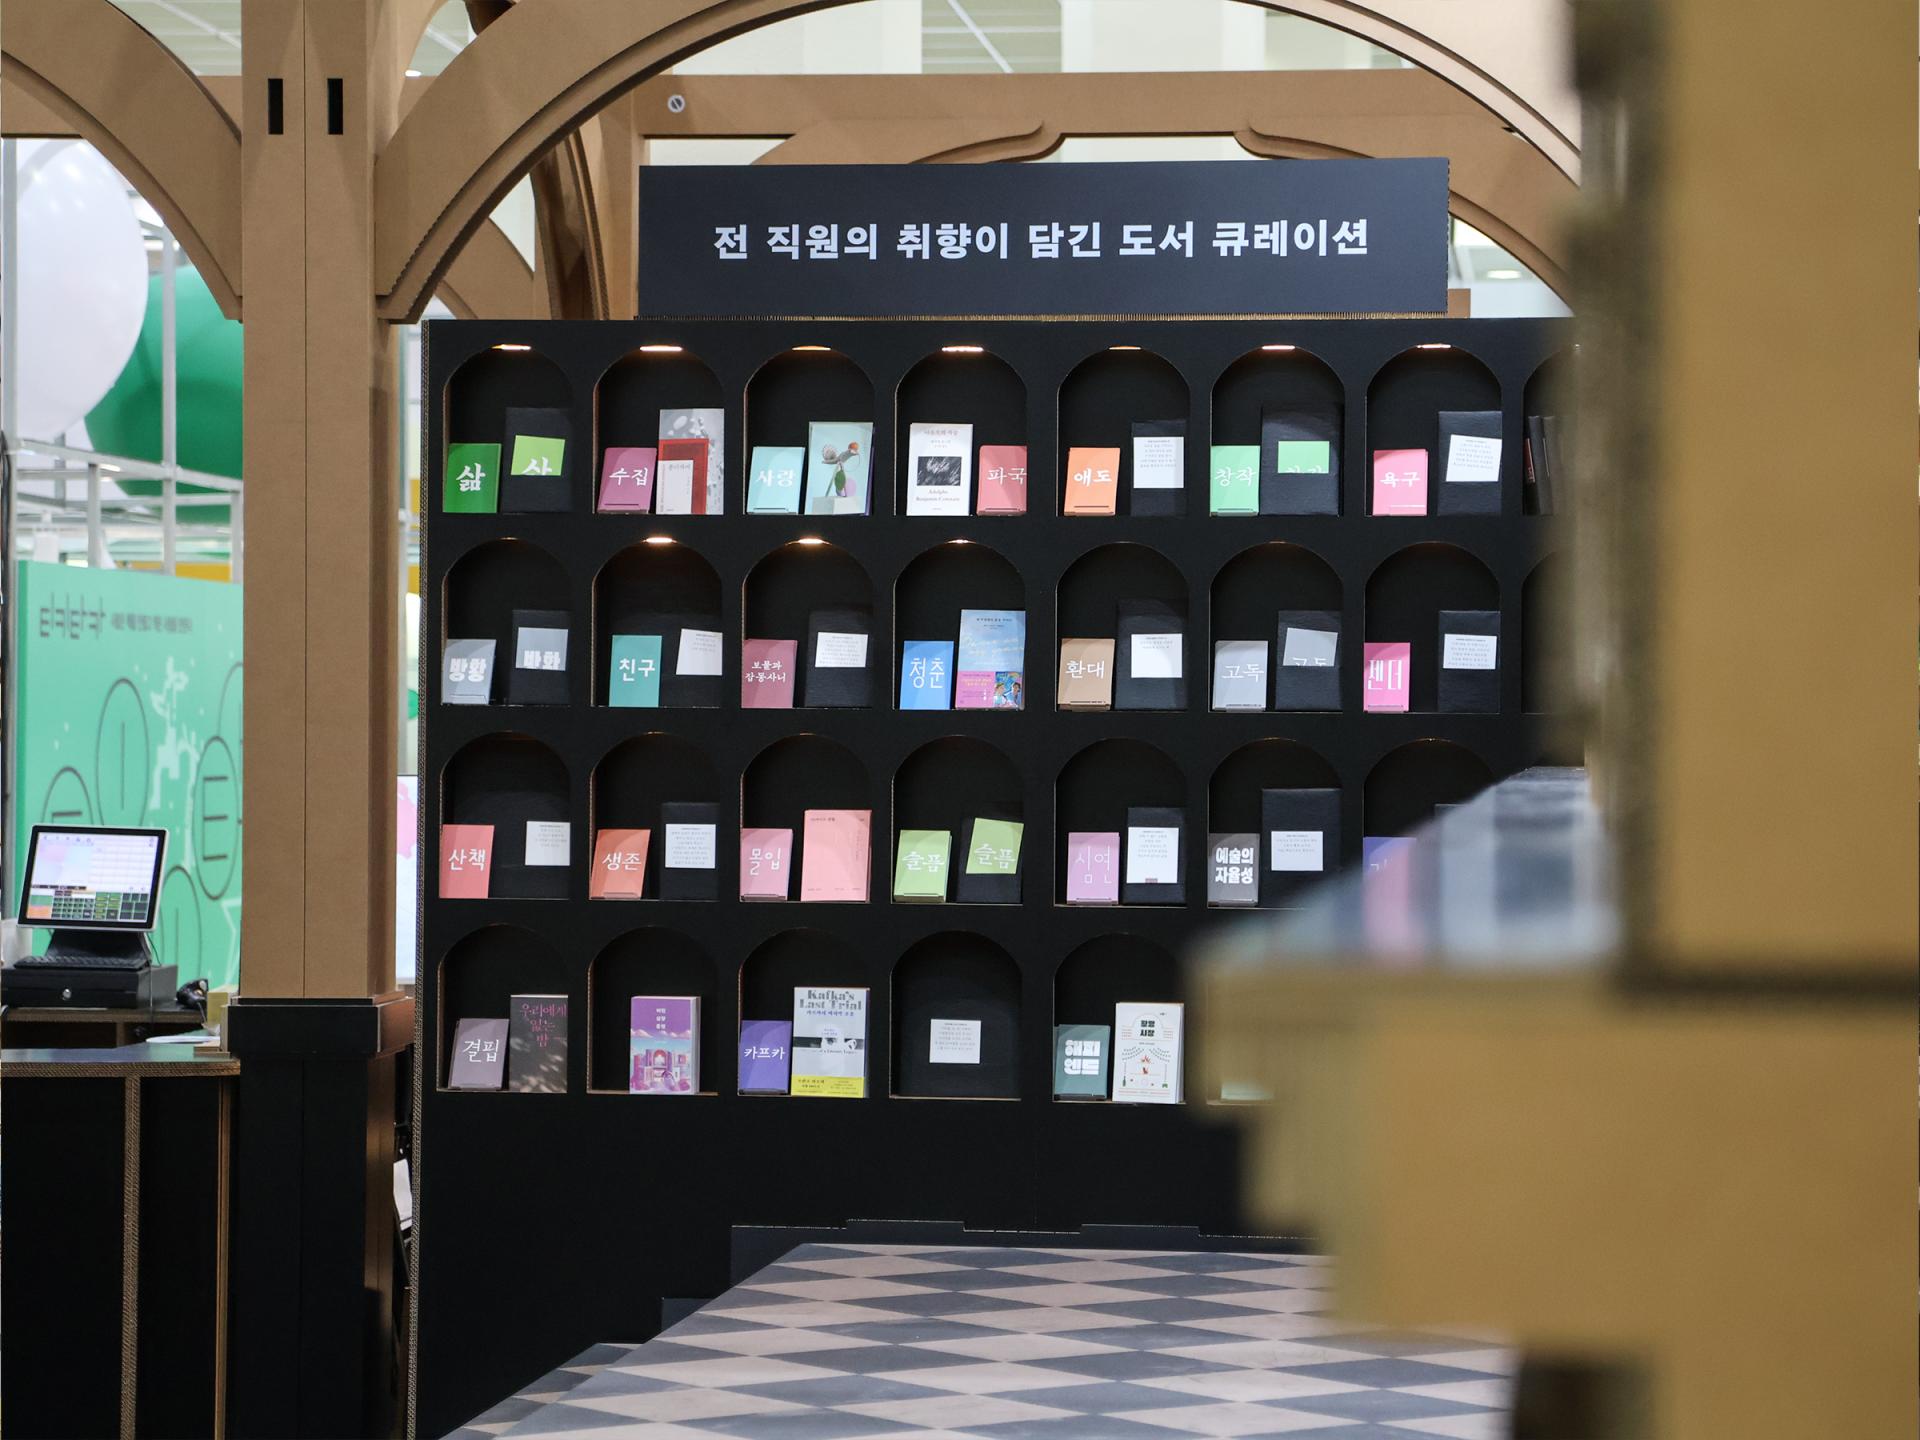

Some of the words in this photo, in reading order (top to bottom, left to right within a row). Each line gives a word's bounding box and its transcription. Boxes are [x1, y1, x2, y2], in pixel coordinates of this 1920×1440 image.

[714, 224, 748, 259] 전
[766, 223, 877, 260] 직원의
[897, 223, 1008, 260] 취향이
[1028, 222, 1101, 258] 담긴
[1119, 221, 1194, 258] 도서
[1212, 219, 1368, 256] 큐레이션
[456, 462, 486, 492] 삶
[608, 467, 649, 487] 수집
[757, 468, 796, 488] 사랑
[987, 466, 1028, 486] 파국
[1073, 467, 1113, 488] 애도
[1215, 466, 1257, 487] 창작
[1380, 471, 1421, 488] 욕구
[448, 657, 488, 683] 방황
[618, 657, 656, 682] 친구
[751, 660, 783, 671] 보물과
[909, 657, 946, 689] 청춘
[1065, 659, 1105, 679] 환대
[1221, 663, 1265, 683] 고독
[1367, 658, 1403, 690] 젠더
[448, 848, 487, 872] 산책
[602, 851, 642, 872] 생존
[749, 847, 782, 876] 몰입
[902, 850, 945, 873] 슬픔
[973, 843, 1017, 870] 슬픔
[1074, 845, 1113, 885] 심연
[1215, 847, 1254, 865] 예술의
[1215, 867, 1254, 885] 자율성
[799, 999, 825, 1009] Last
[828, 1000, 862, 1011] Trial
[807, 989, 855, 1001] Kafka's
[520, 1003, 567, 1017] 우리에게
[462, 1038, 500, 1063] 결핍
[743, 1046, 786, 1061] 카프카
